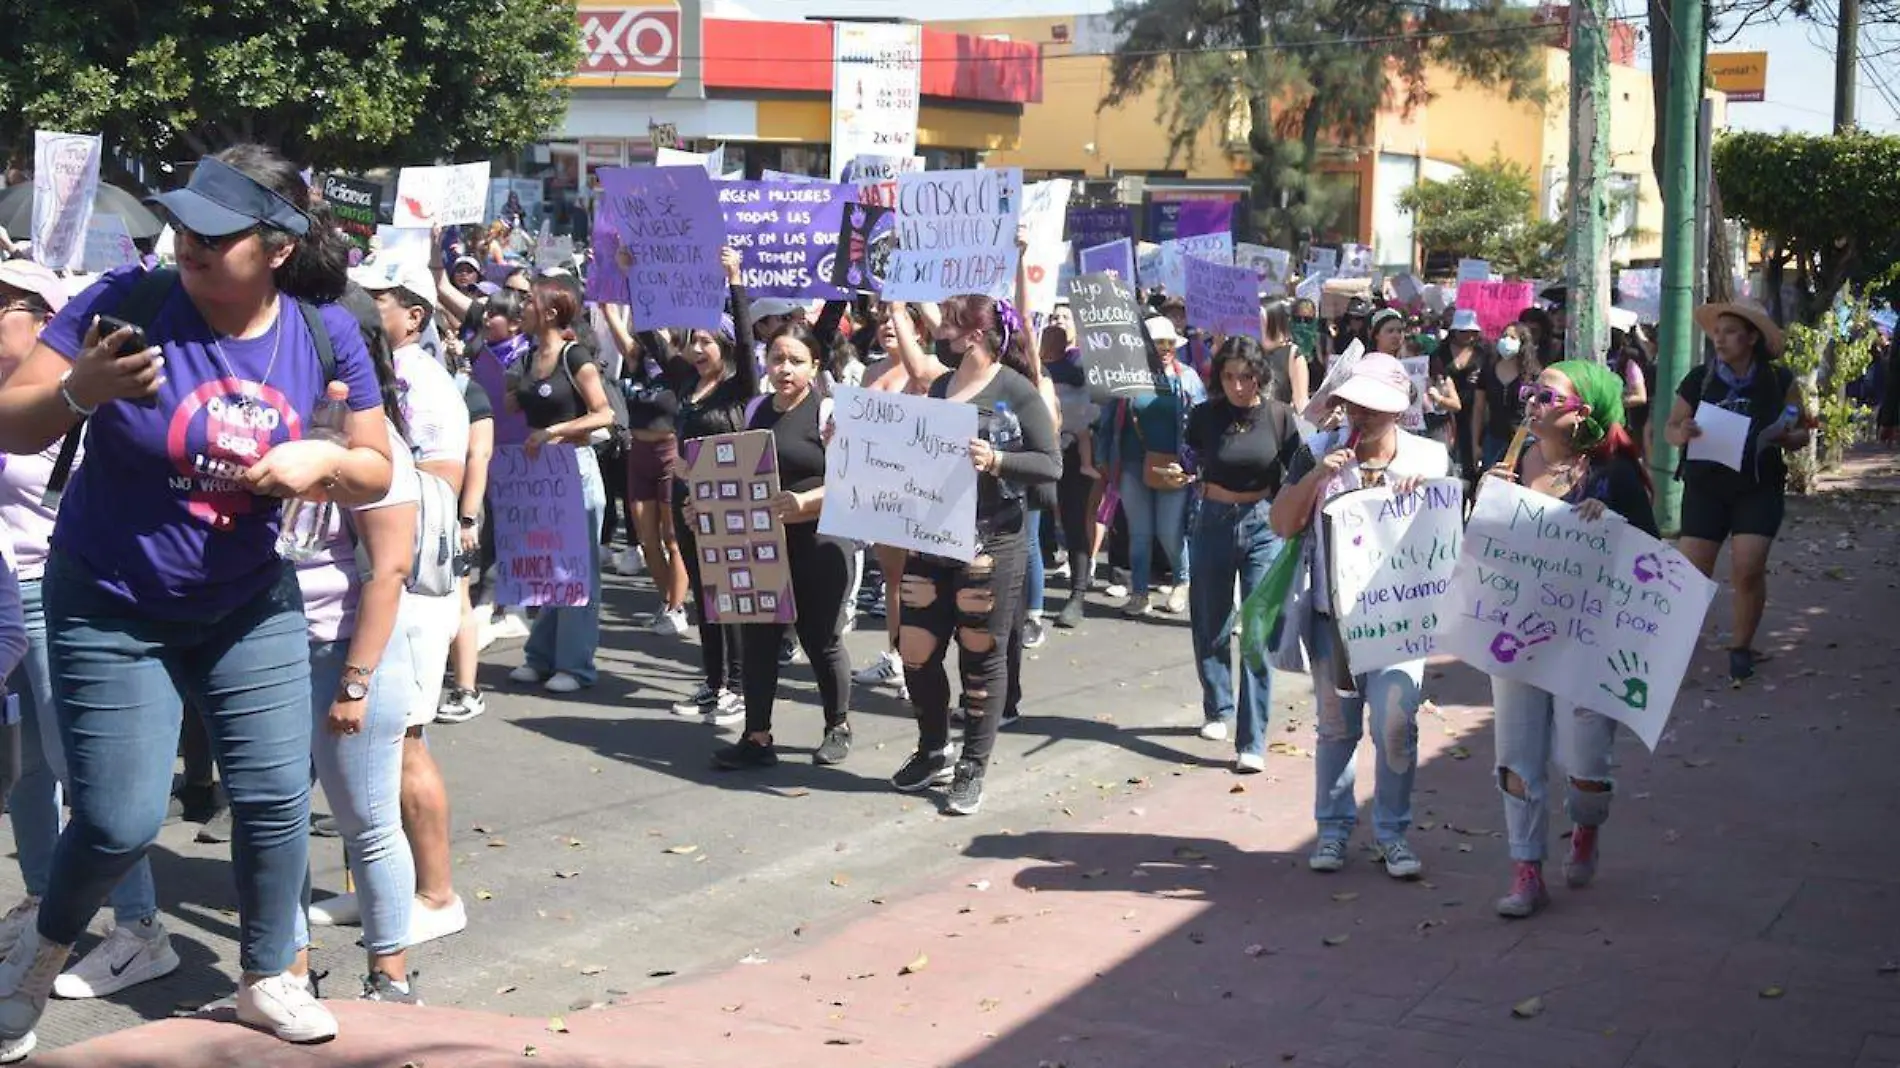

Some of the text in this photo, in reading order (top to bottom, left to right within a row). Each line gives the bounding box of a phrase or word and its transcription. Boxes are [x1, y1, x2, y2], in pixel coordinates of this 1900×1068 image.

[577, 8, 673, 67] XXO
[719, 188, 831, 204] RGEN MUJERES
[736, 211, 779, 224] TODAS
[788, 211, 811, 224] LAS
[758, 233, 776, 245] EN
[784, 233, 807, 245] LAS
[813, 232, 839, 245] QUE
[758, 251, 806, 264] TOMEN
[742, 268, 812, 288] ISIONES
[1087, 330, 1113, 352] NO
[195, 453, 248, 480] LIBR
[168, 476, 192, 491] NO
[512, 555, 555, 579] NUNCA
[527, 580, 587, 606] TOCAR
[1596, 564, 1634, 606] hoy
